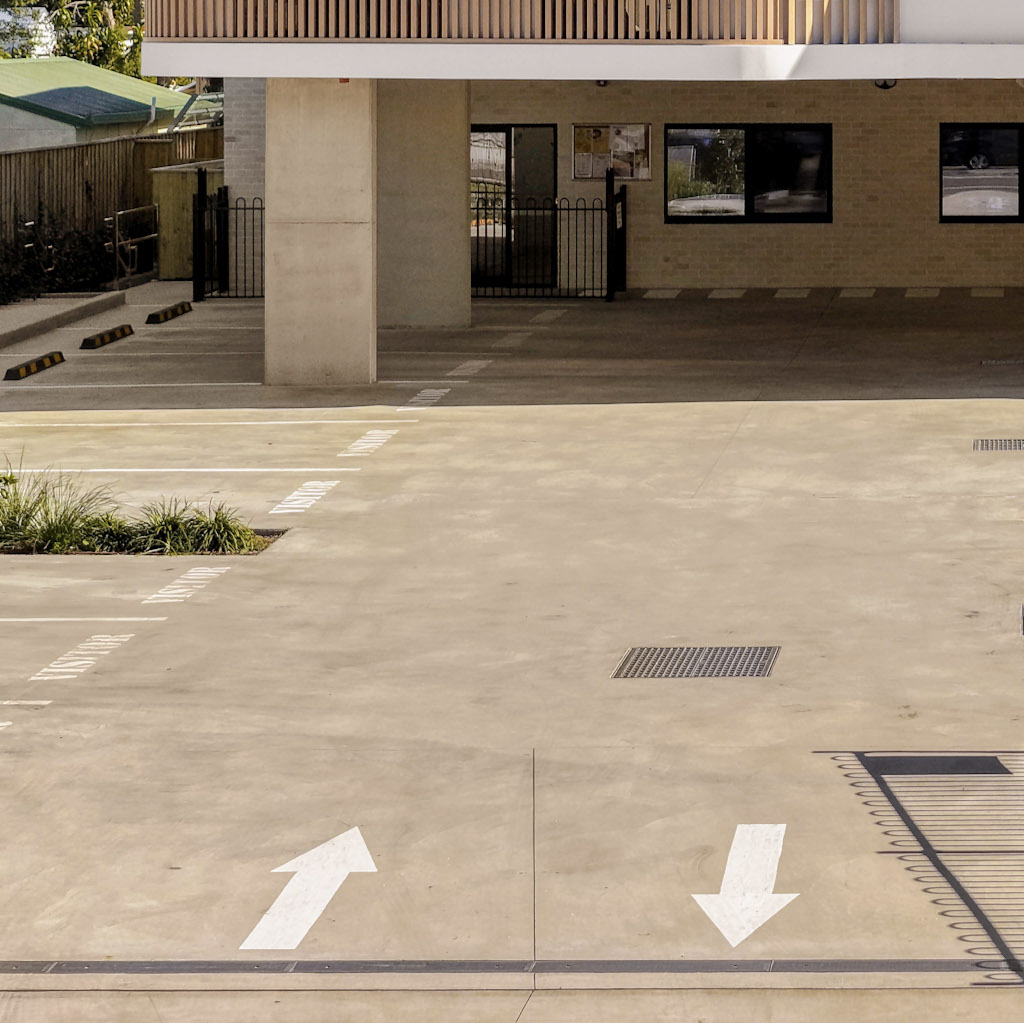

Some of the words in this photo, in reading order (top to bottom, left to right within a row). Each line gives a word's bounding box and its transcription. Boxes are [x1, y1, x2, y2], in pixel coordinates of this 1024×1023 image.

[268, 480, 340, 514] VISITOR
[141, 566, 231, 604] VISITOR
[27, 633, 135, 681] VISITOR
